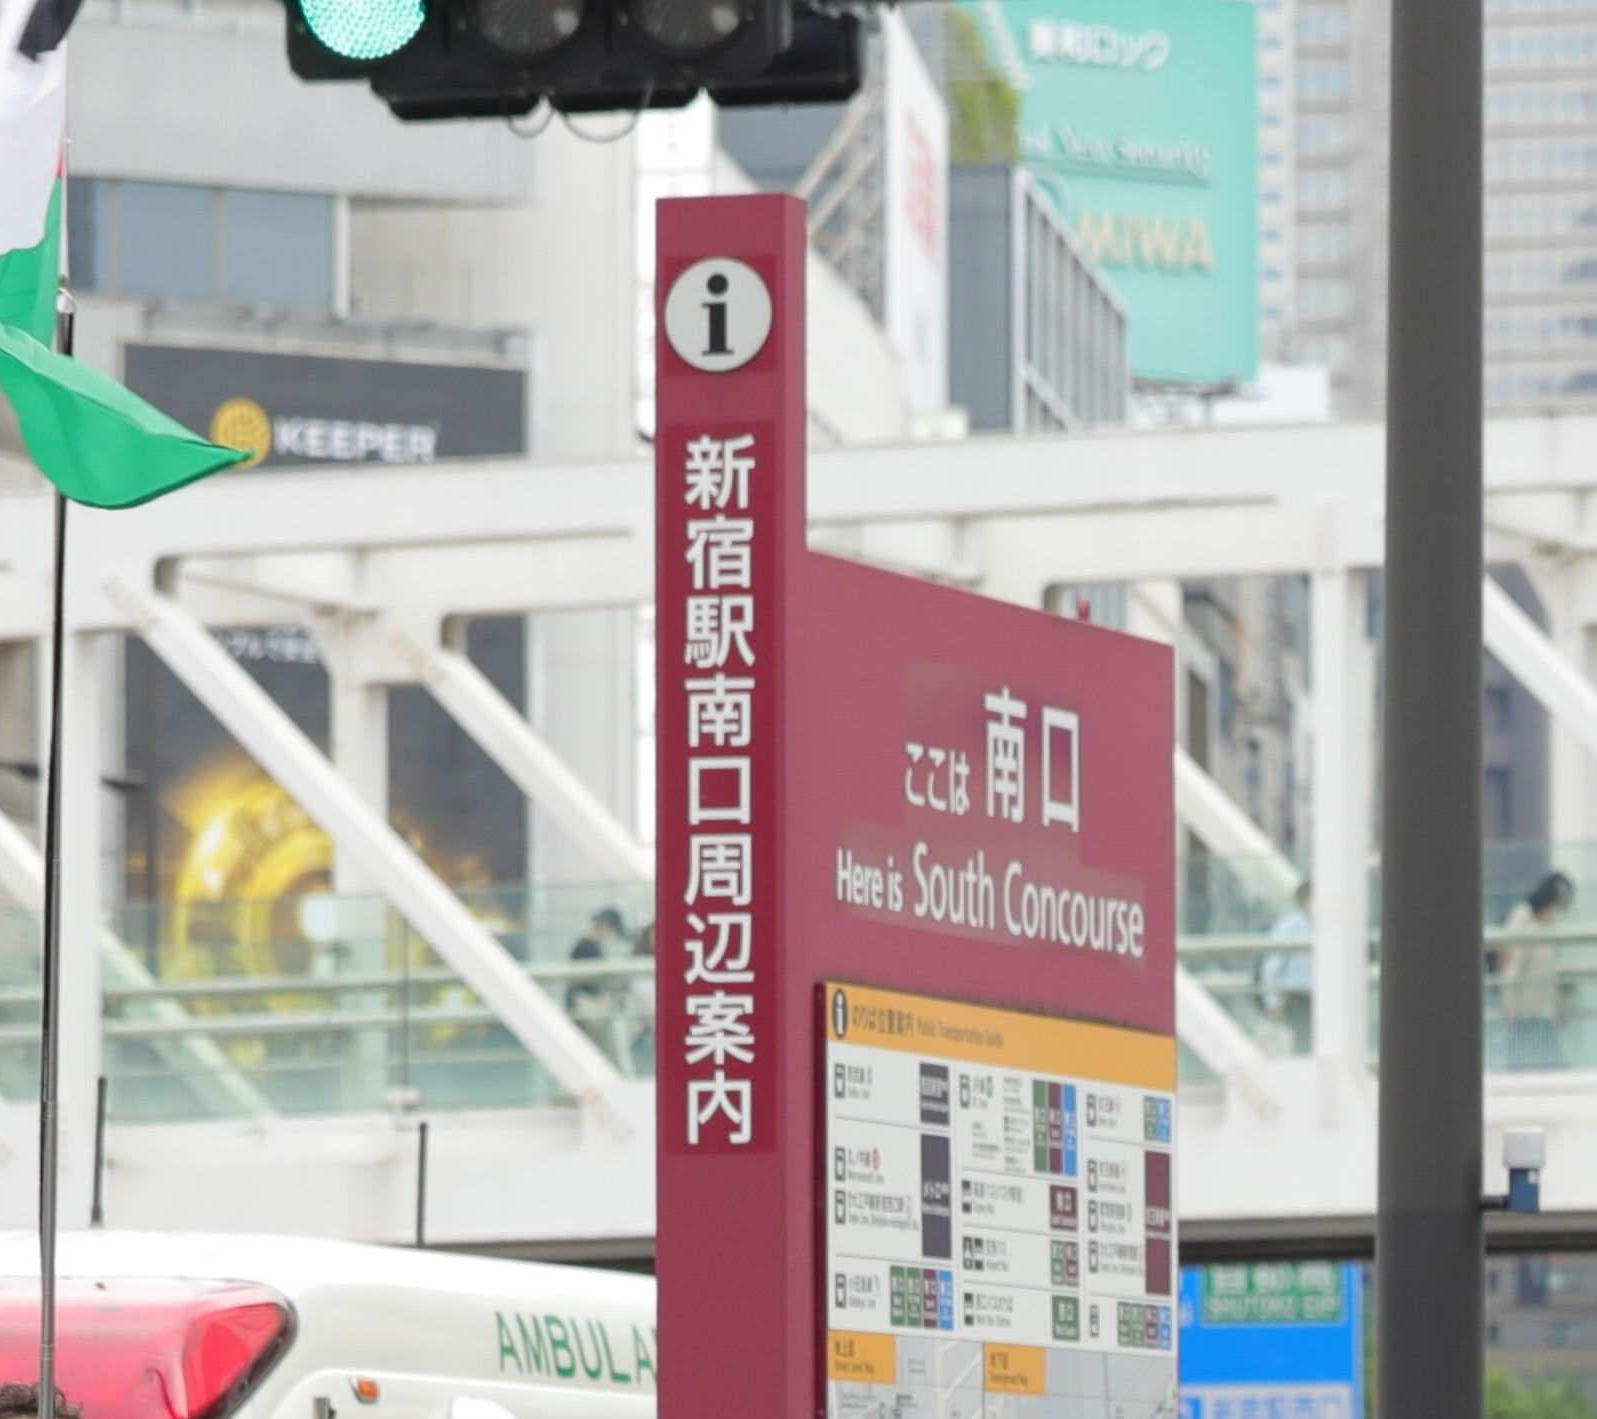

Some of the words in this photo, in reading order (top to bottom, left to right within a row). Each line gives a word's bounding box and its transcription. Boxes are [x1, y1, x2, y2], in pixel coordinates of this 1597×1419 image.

[1076, 208, 1215, 275] MIWA
[274, 416, 438, 463] KEEPER
[684, 434, 756, 1146] 新宿駅南口周辺案内
[904, 740, 971, 816] ここは
[983, 684, 1082, 834] 南口
[835, 847, 882, 905] Here
[884, 856, 904, 914] is
[912, 840, 996, 927] South
[1001, 862, 1146, 958] Concourse
[492, 1308, 657, 1386] AMBULA
